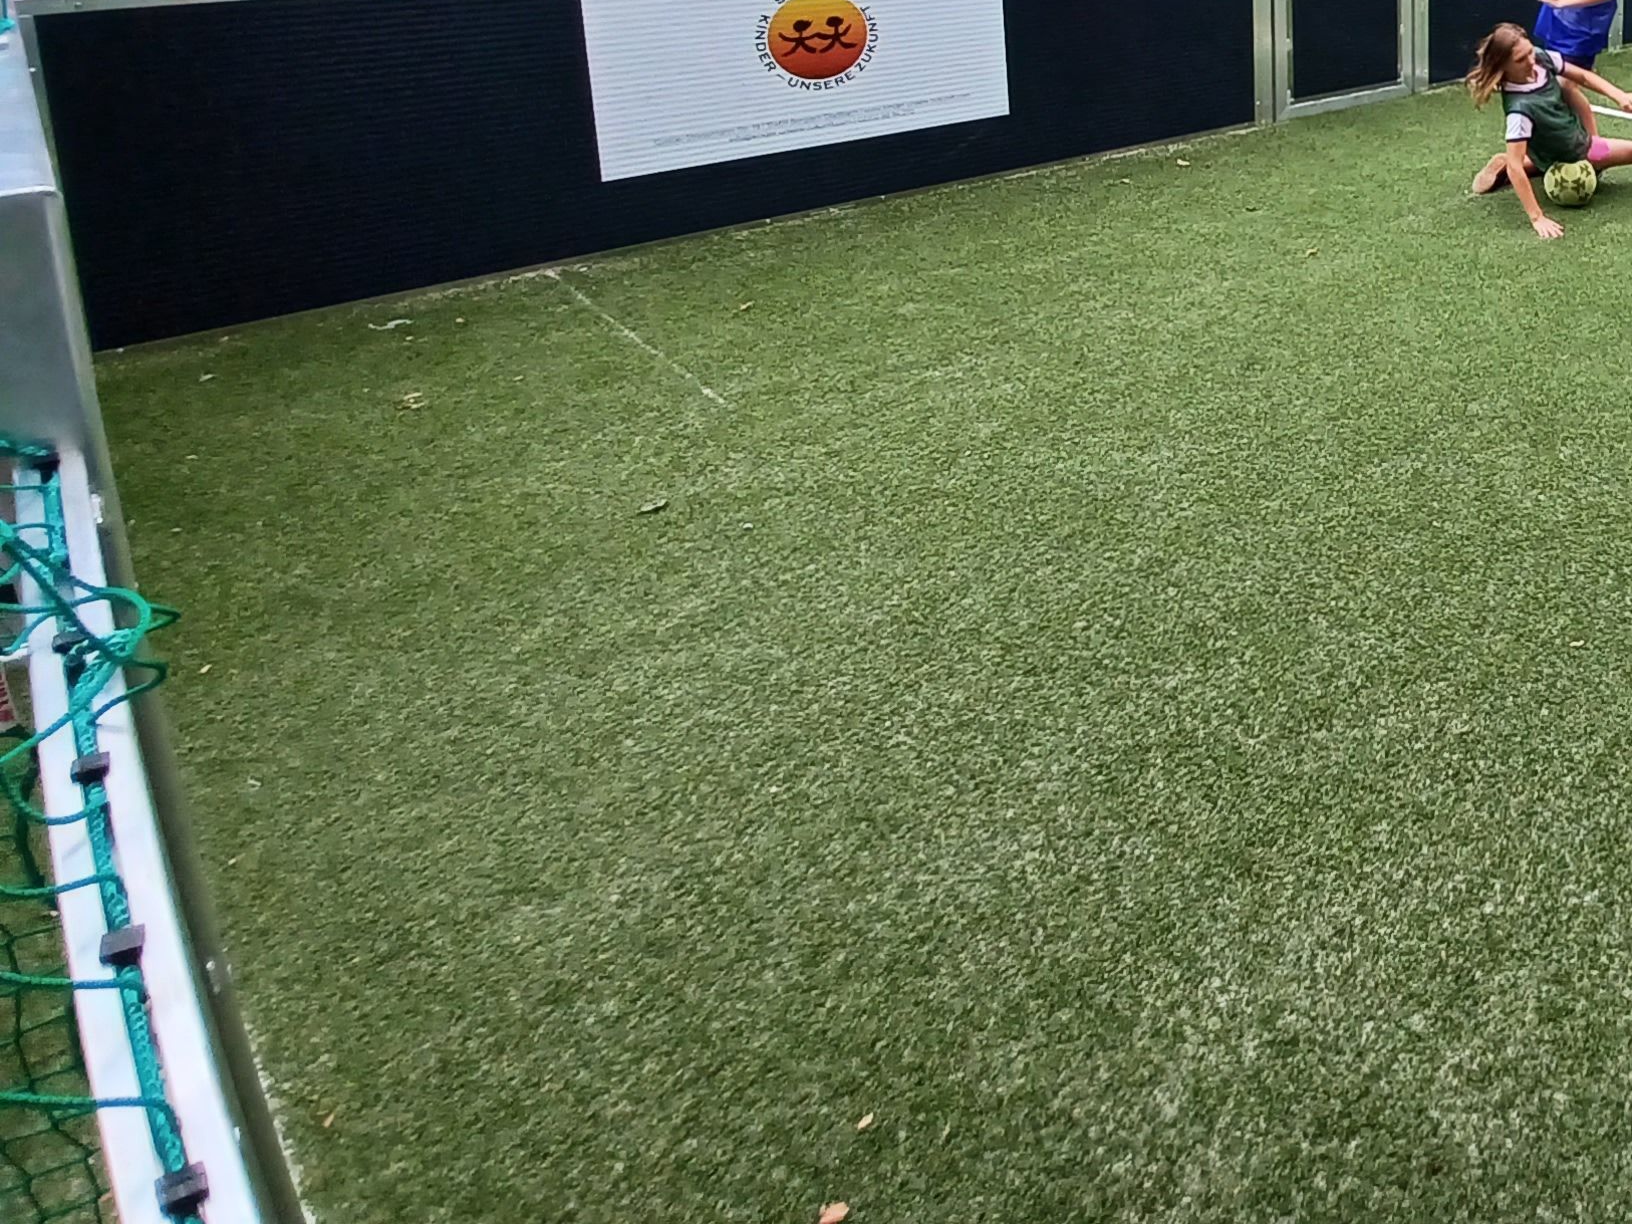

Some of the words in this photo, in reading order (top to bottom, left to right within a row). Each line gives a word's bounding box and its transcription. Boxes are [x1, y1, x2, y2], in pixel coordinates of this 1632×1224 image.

[754, 14, 777, 72] KINDER
[787, 71, 856, 91] UNSERE
[854, 6, 879, 72] ZUKUNFT
